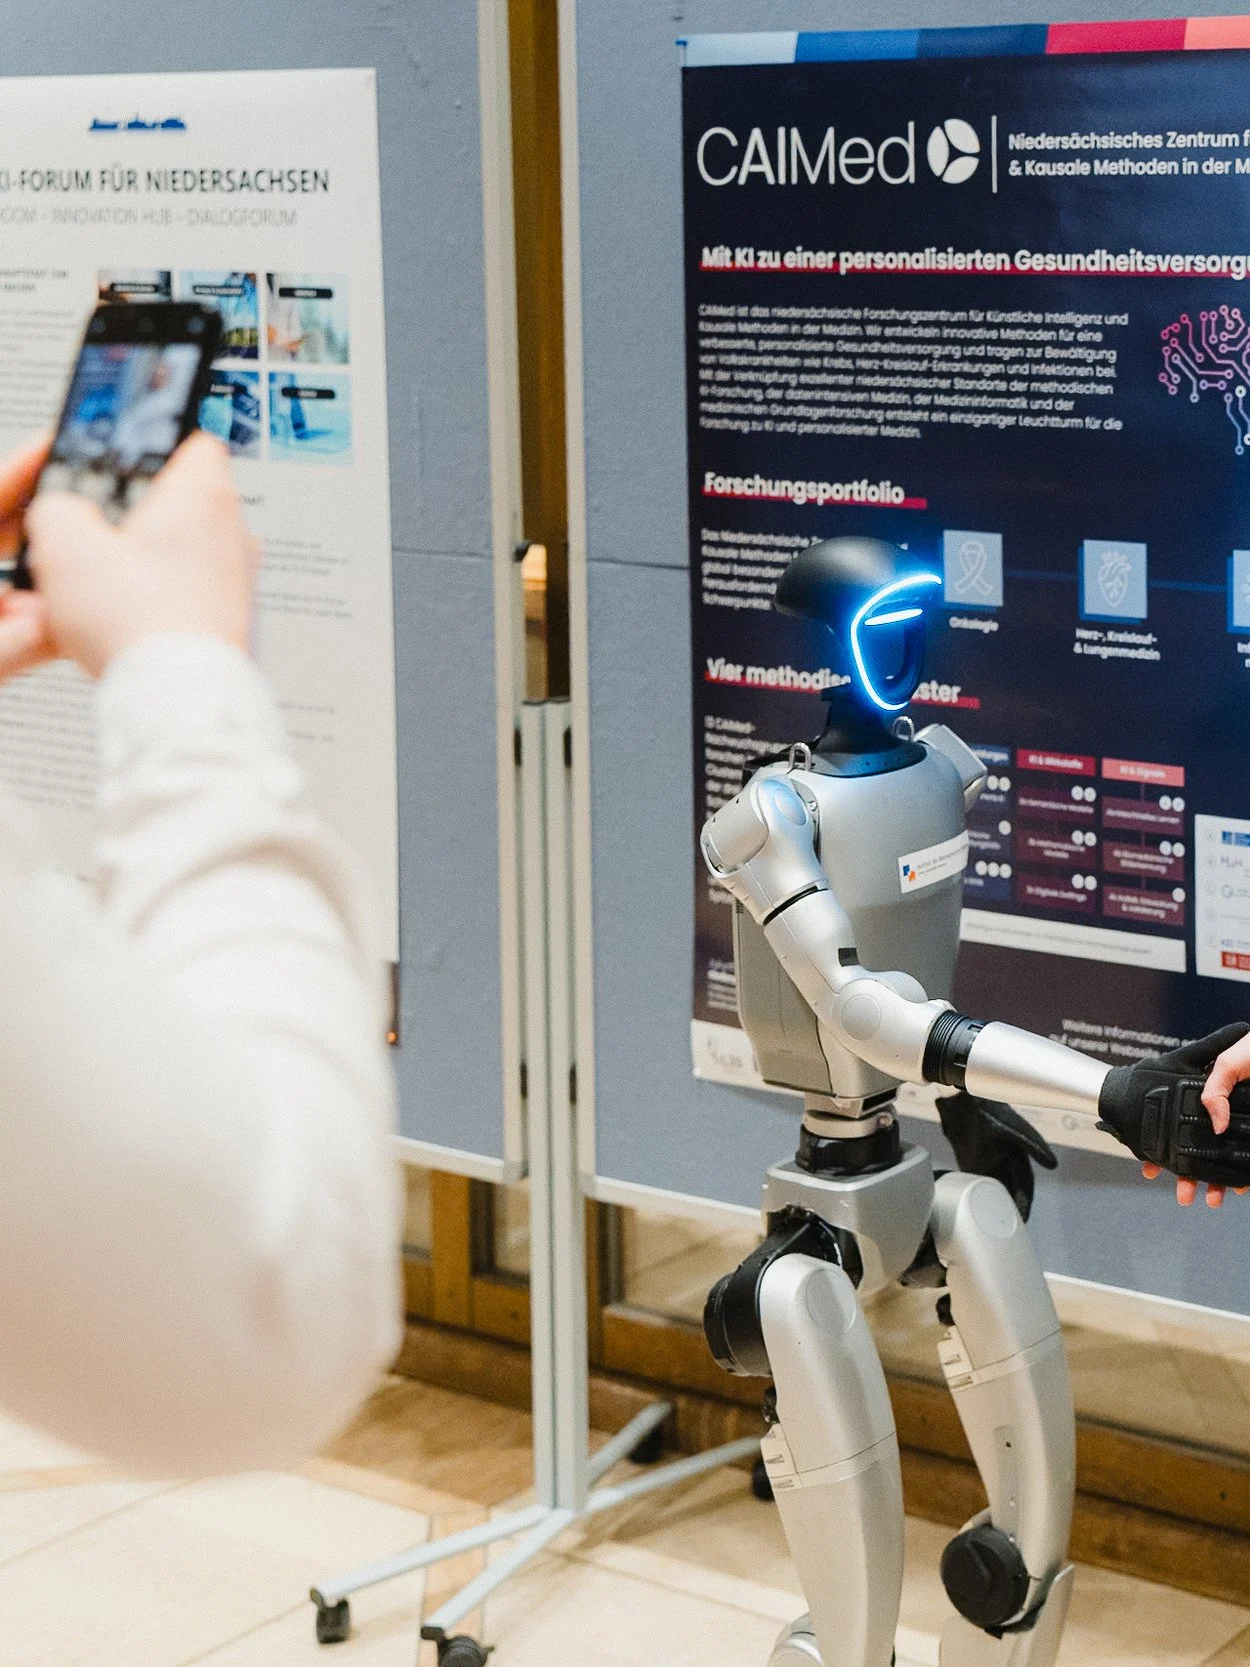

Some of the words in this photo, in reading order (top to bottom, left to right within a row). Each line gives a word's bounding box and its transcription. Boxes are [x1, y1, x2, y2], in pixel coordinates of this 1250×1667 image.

[1007, 130, 1163, 150] Niedersächsisches
[1166, 129, 1239, 147] Zentrum
[697, 121, 915, 186] CAIMed
[1008, 157, 1022, 175] &
[1024, 157, 1090, 175] Kausale
[1093, 156, 1179, 174] Methoden
[1181, 156, 1198, 174] in
[1201, 156, 1230, 174] der
[98, 163, 138, 192] FÜR
[144, 169, 329, 192] NIEDERSACHSEN
[701, 244, 731, 267] Mit
[734, 245, 754, 267] KI
[757, 251, 780, 267] zu
[784, 245, 834, 268] einer
[839, 247, 1010, 274] personalisierten
[1104, 313, 1129, 326] und
[705, 471, 905, 505] Forschungsportfolio
[706, 657, 743, 682] Vier
